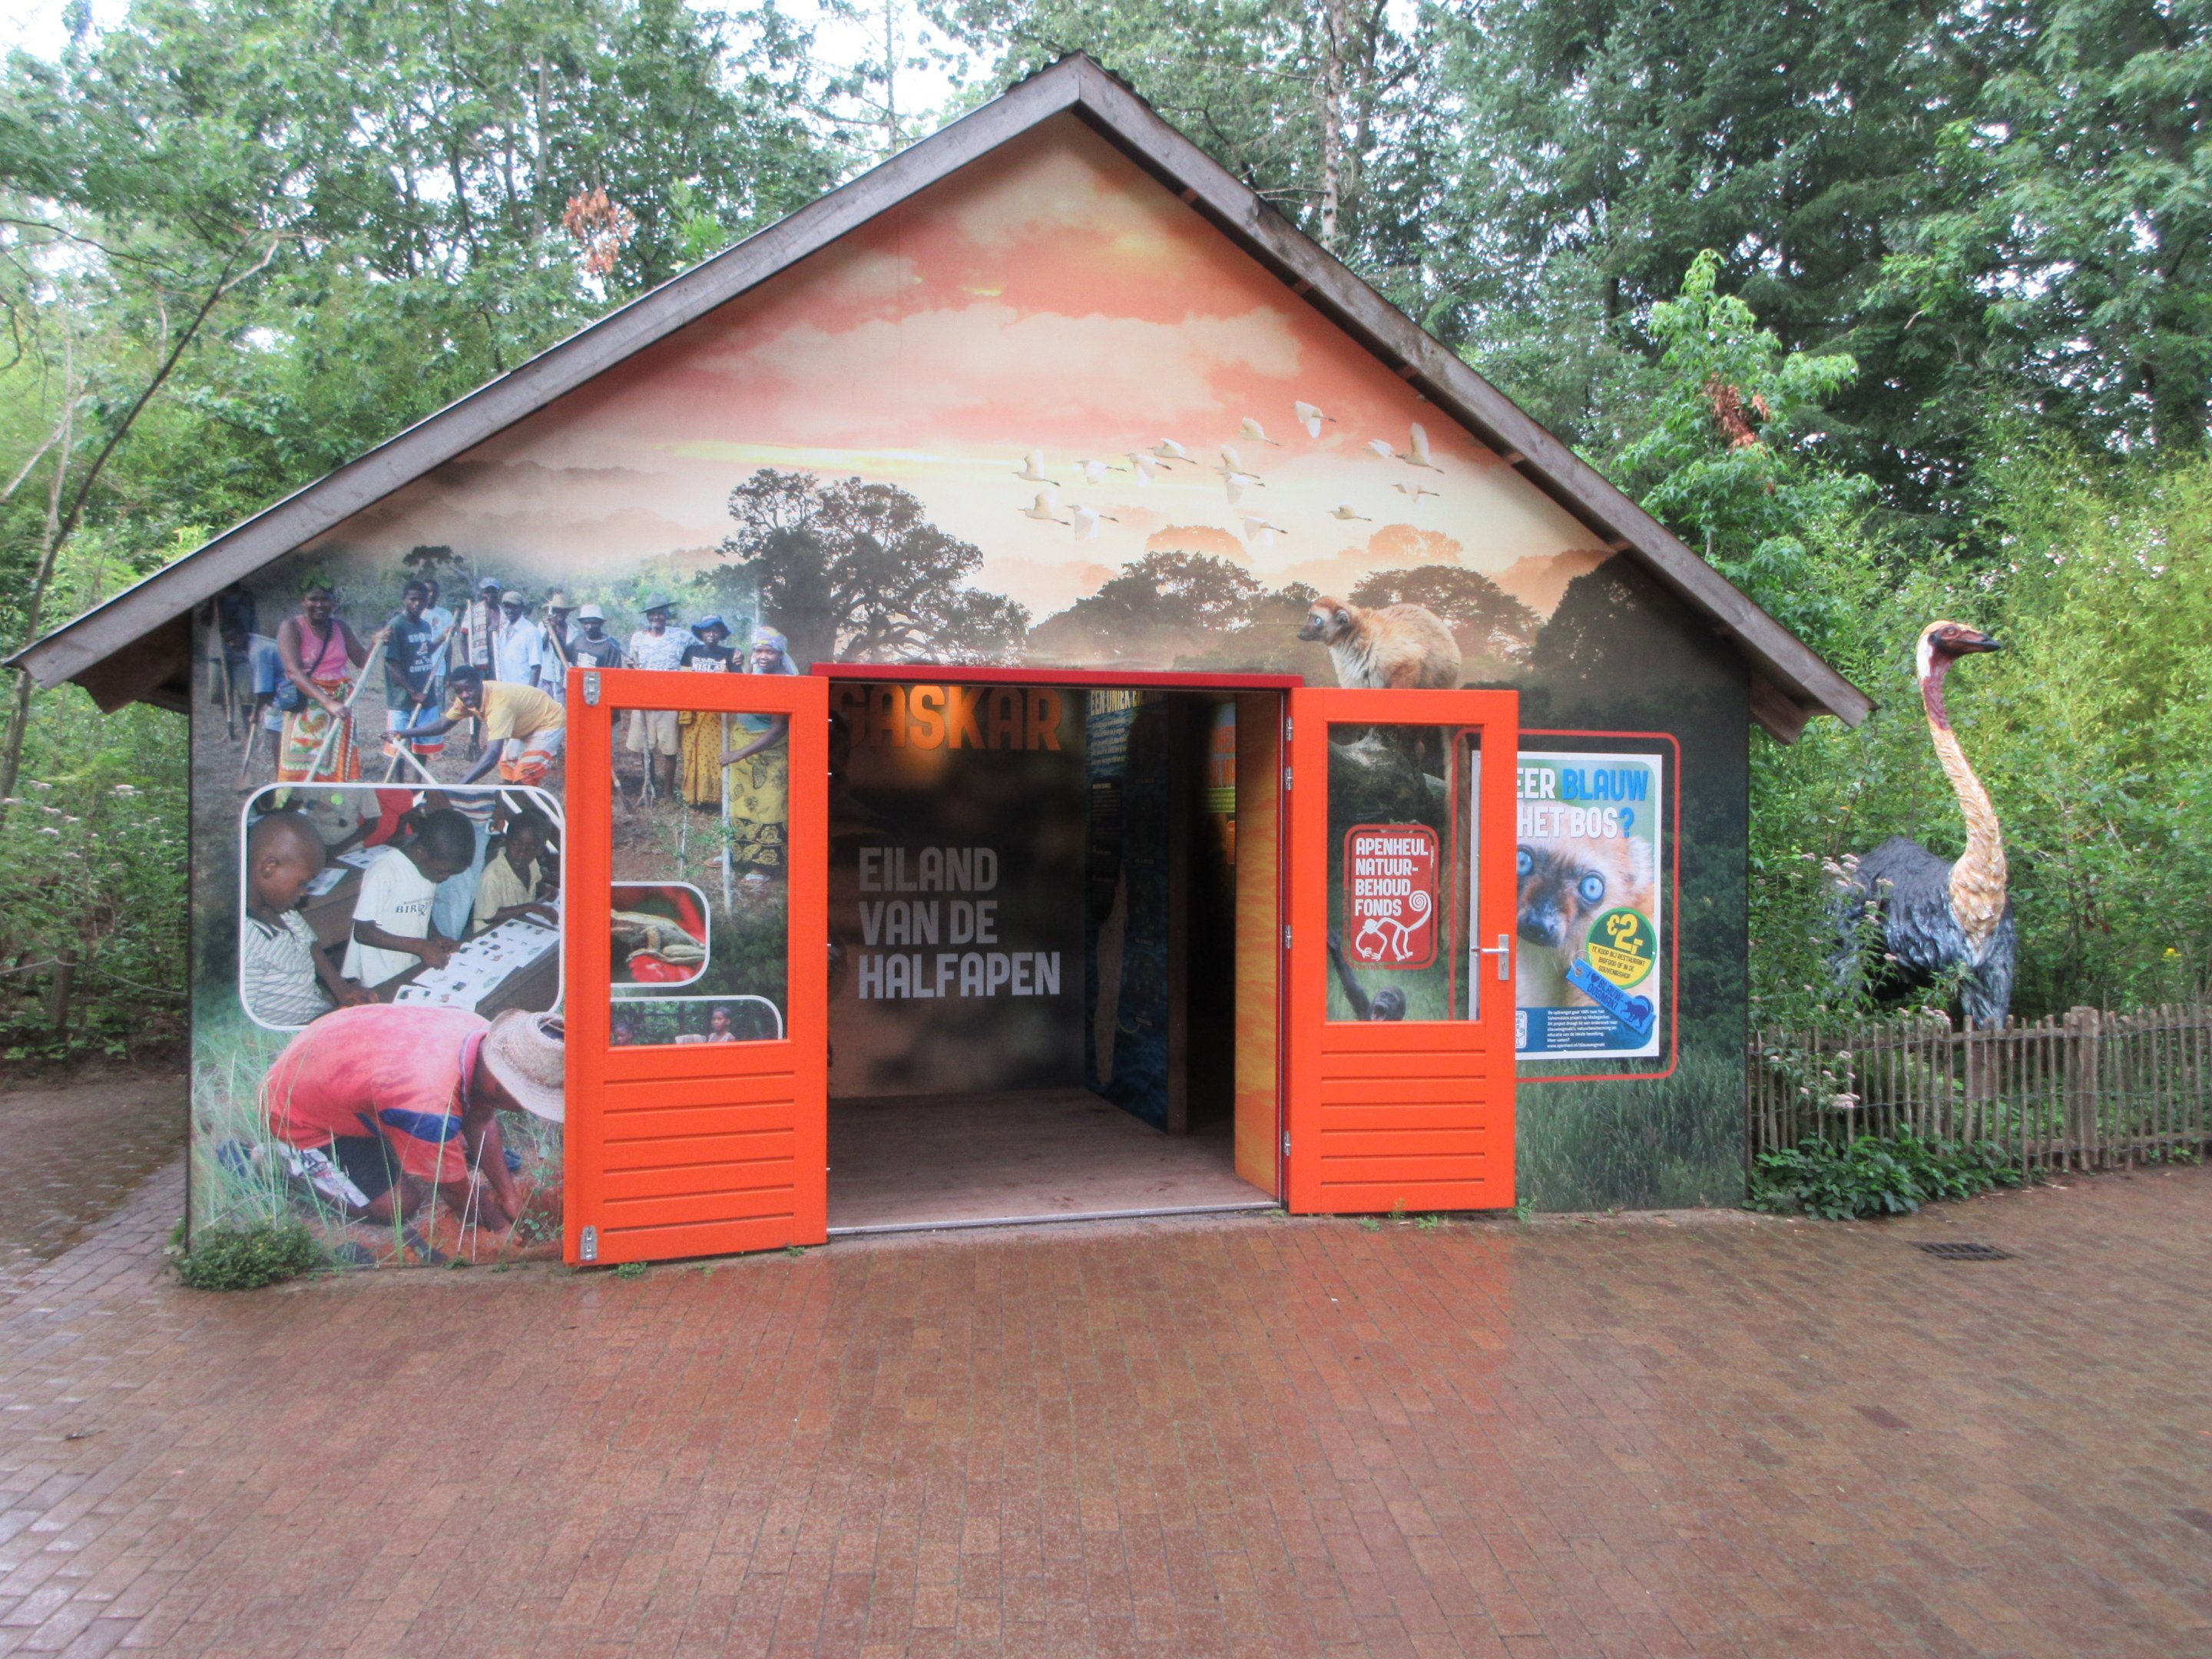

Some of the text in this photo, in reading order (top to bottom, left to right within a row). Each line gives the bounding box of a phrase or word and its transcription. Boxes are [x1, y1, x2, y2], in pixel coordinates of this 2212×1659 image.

[1562, 769, 1648, 800] BLAUW
[1518, 807, 1634, 838] HET BOS?
[1356, 838, 1429, 856] APENHEUL
[859, 847, 998, 891] EILAND
[1356, 859, 1419, 876] NATUUR-
[1356, 879, 1411, 896] BEHOUD
[1355, 899, 1402, 916] FONDS
[859, 900, 998, 945] VAN DE
[859, 952, 1060, 998] HALFAPEN
[1586, 970, 1592, 979] I
[1587, 983, 1618, 1011] OOGMAKI
